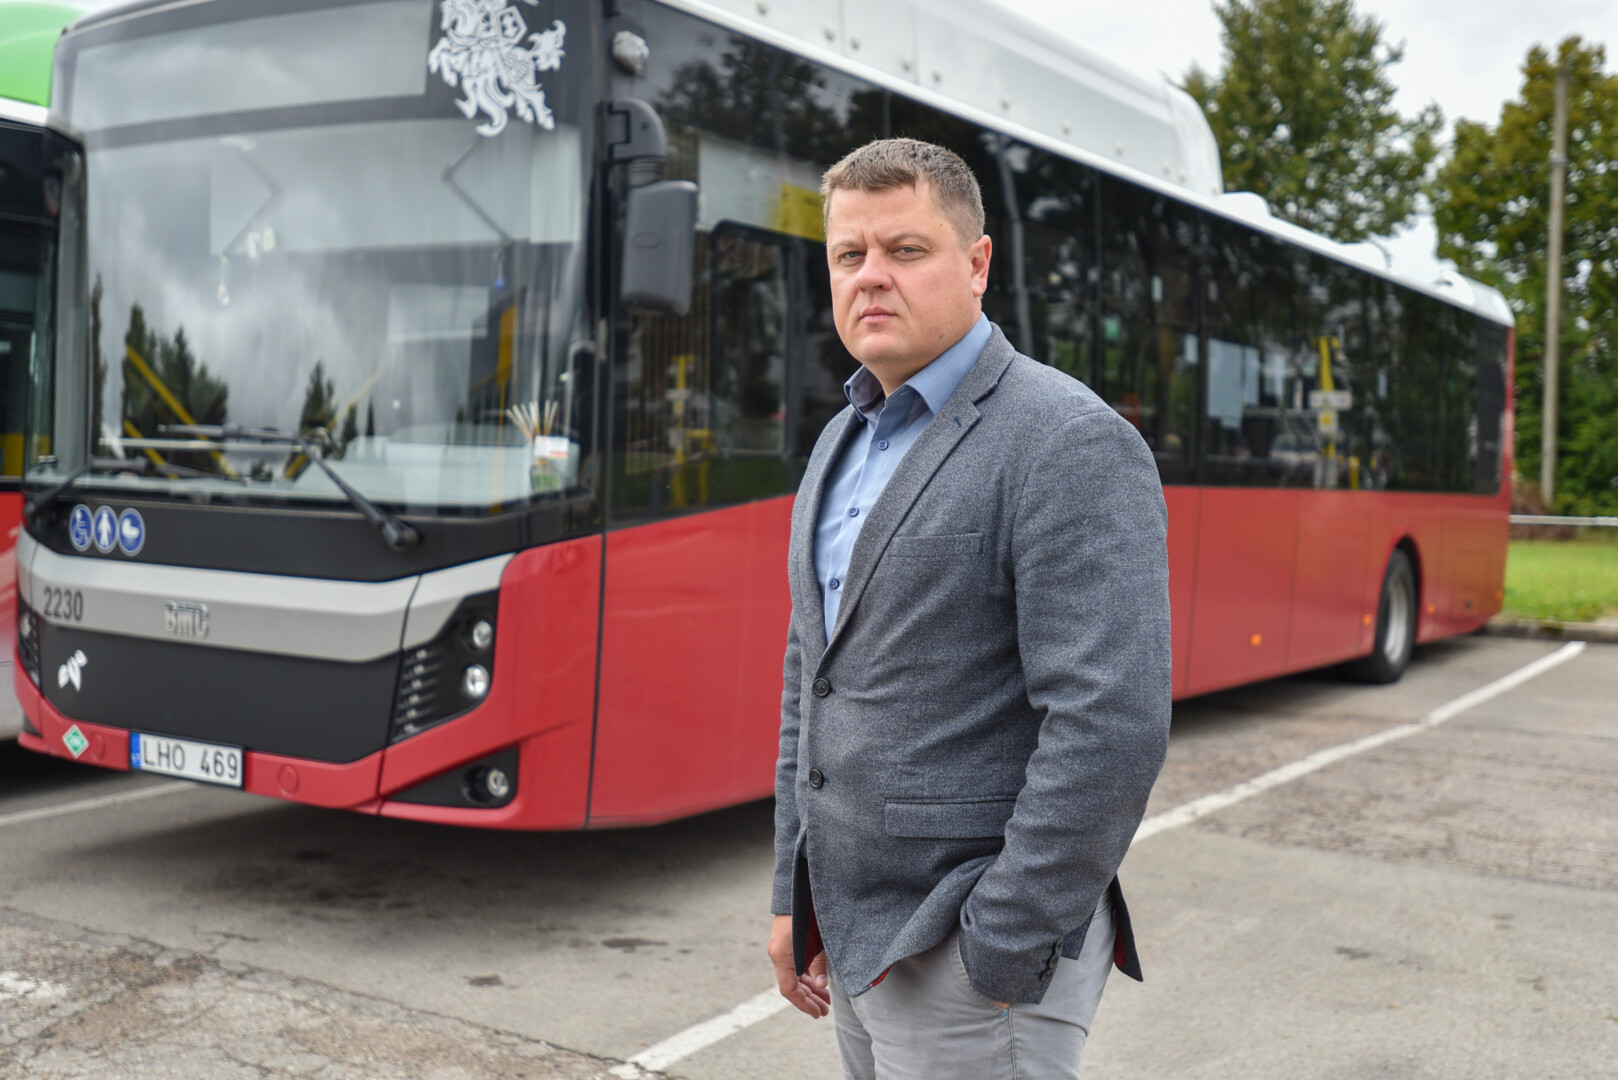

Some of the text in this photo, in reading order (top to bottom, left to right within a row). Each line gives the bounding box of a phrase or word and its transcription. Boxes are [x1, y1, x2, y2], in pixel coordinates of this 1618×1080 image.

[44, 585, 84, 621] 2230
[143, 739, 238, 779] LHO 469
